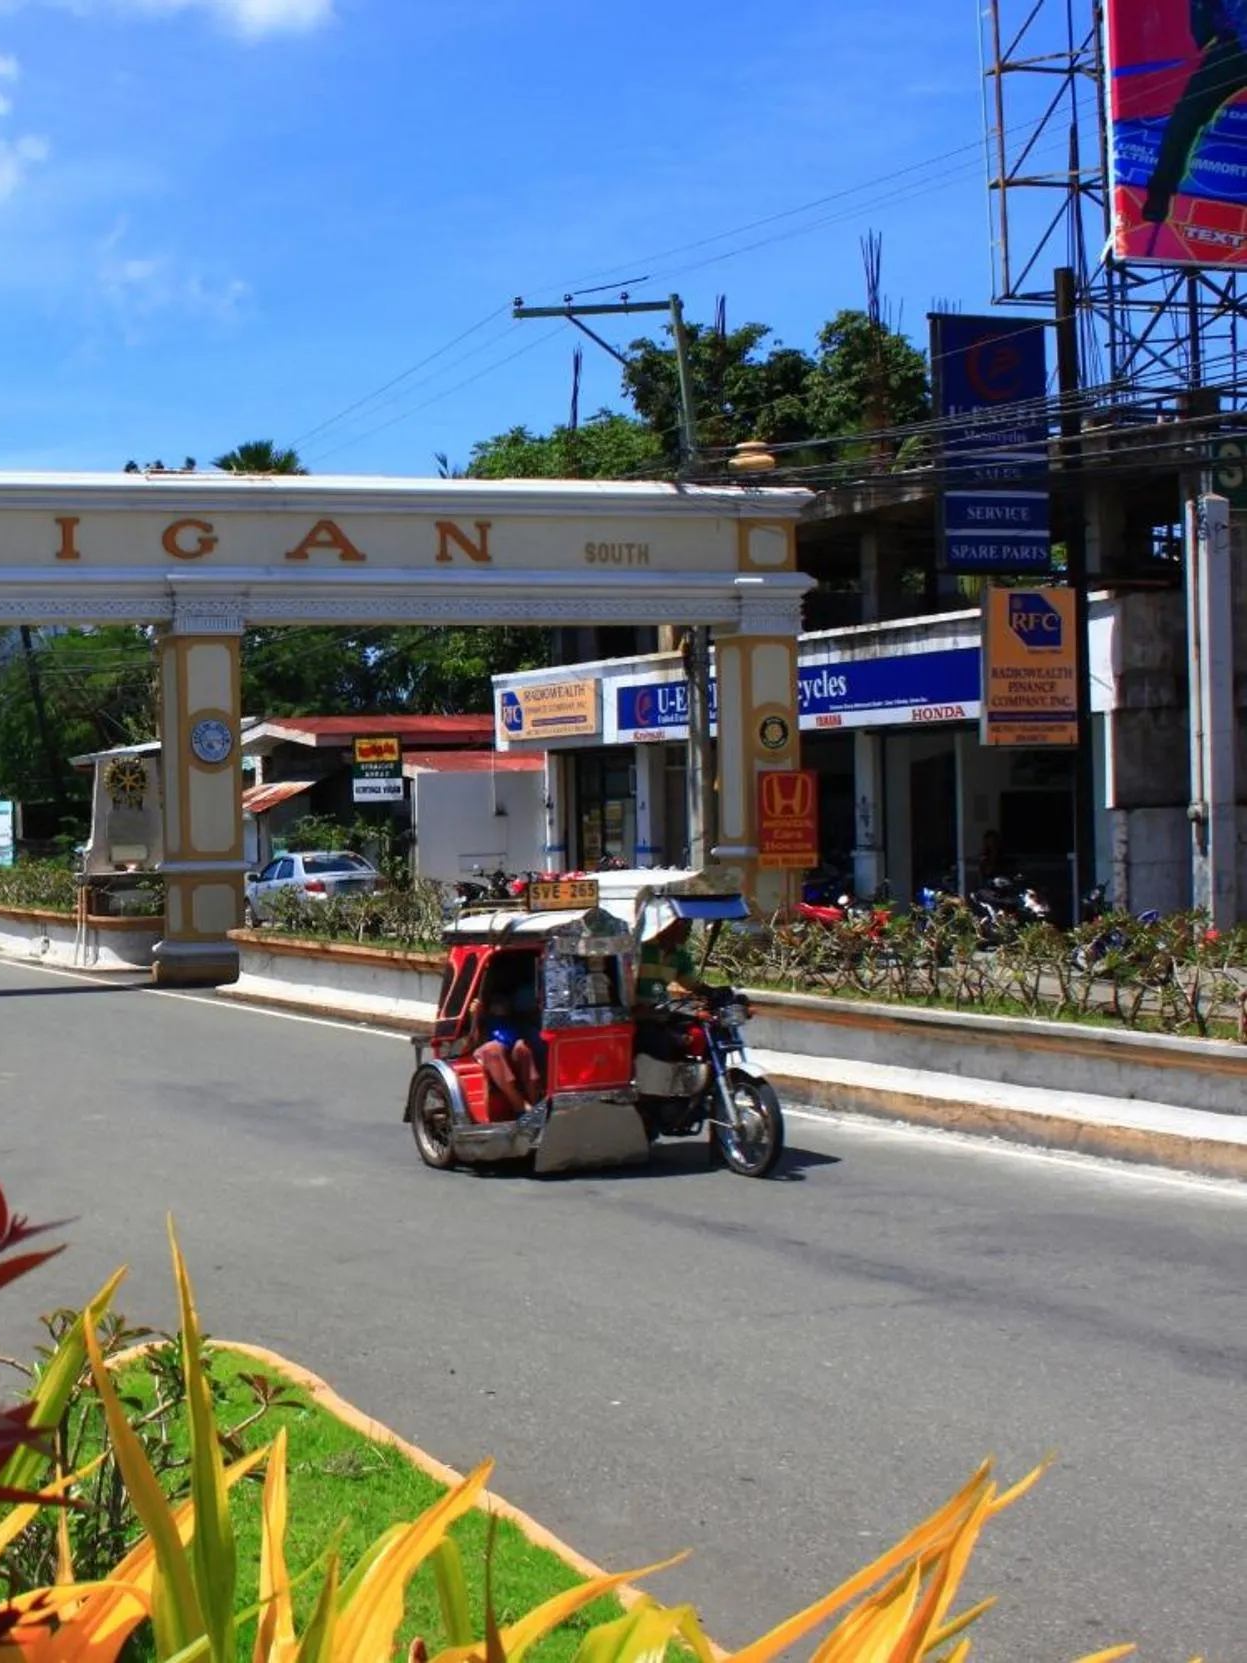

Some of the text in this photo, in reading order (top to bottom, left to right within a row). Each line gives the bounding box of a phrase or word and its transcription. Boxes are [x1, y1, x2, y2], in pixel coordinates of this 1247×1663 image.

[1190, 157, 1247, 178] IMMORT
[1184, 227, 1245, 246] TEXT
[966, 505, 1030, 520] SERVICE
[584, 542, 650, 566] SOUTH
[951, 544, 1047, 560] SPARE PARTS
[1011, 612, 1059, 633] RFC
[1008, 681, 1056, 693] FINANCE
[911, 705, 966, 721] HONDA
